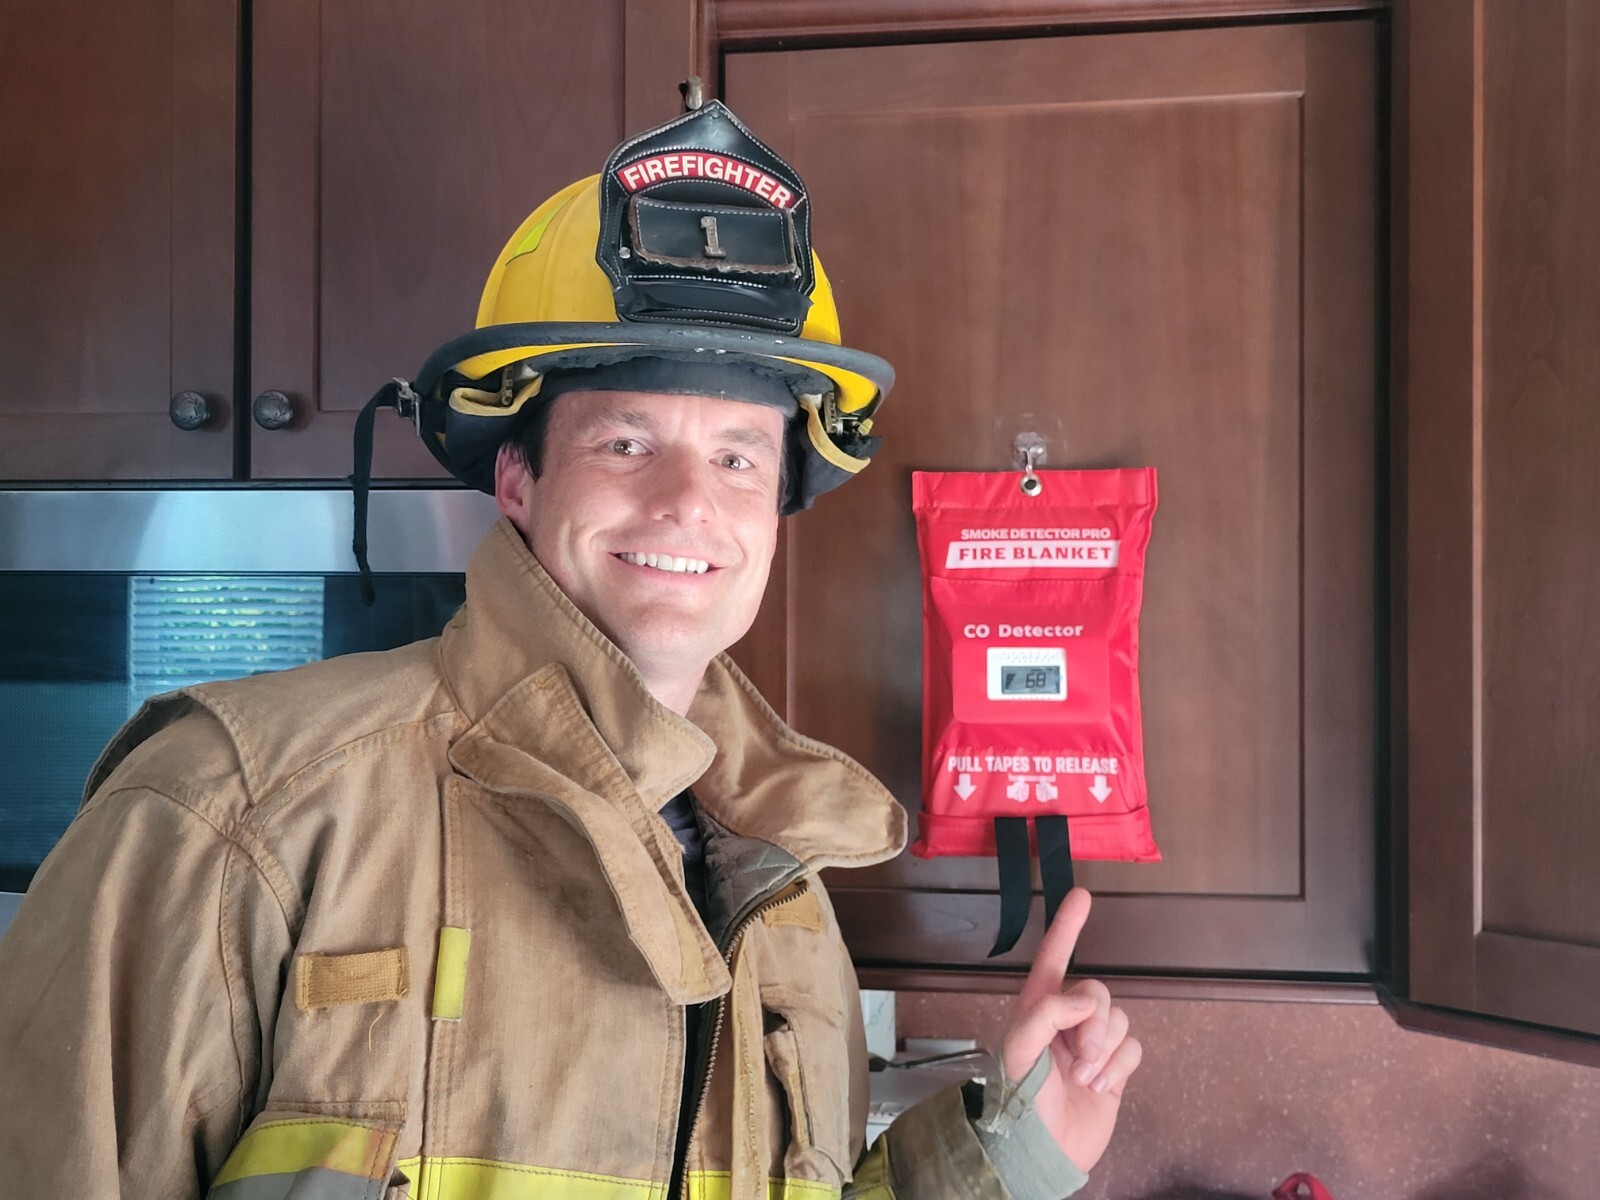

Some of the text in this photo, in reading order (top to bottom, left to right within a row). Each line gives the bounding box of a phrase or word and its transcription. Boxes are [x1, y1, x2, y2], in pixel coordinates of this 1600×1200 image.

[623, 155, 792, 209] FIREFIGHTER
[701, 215, 726, 257] 1
[961, 527, 1111, 540] SMOKE DETECTOR PRO
[959, 547, 1112, 561] FIRE BLANKET
[963, 624, 1084, 639] CO Detector
[948, 756, 1118, 774] PULL TAPES TO RELEASE
